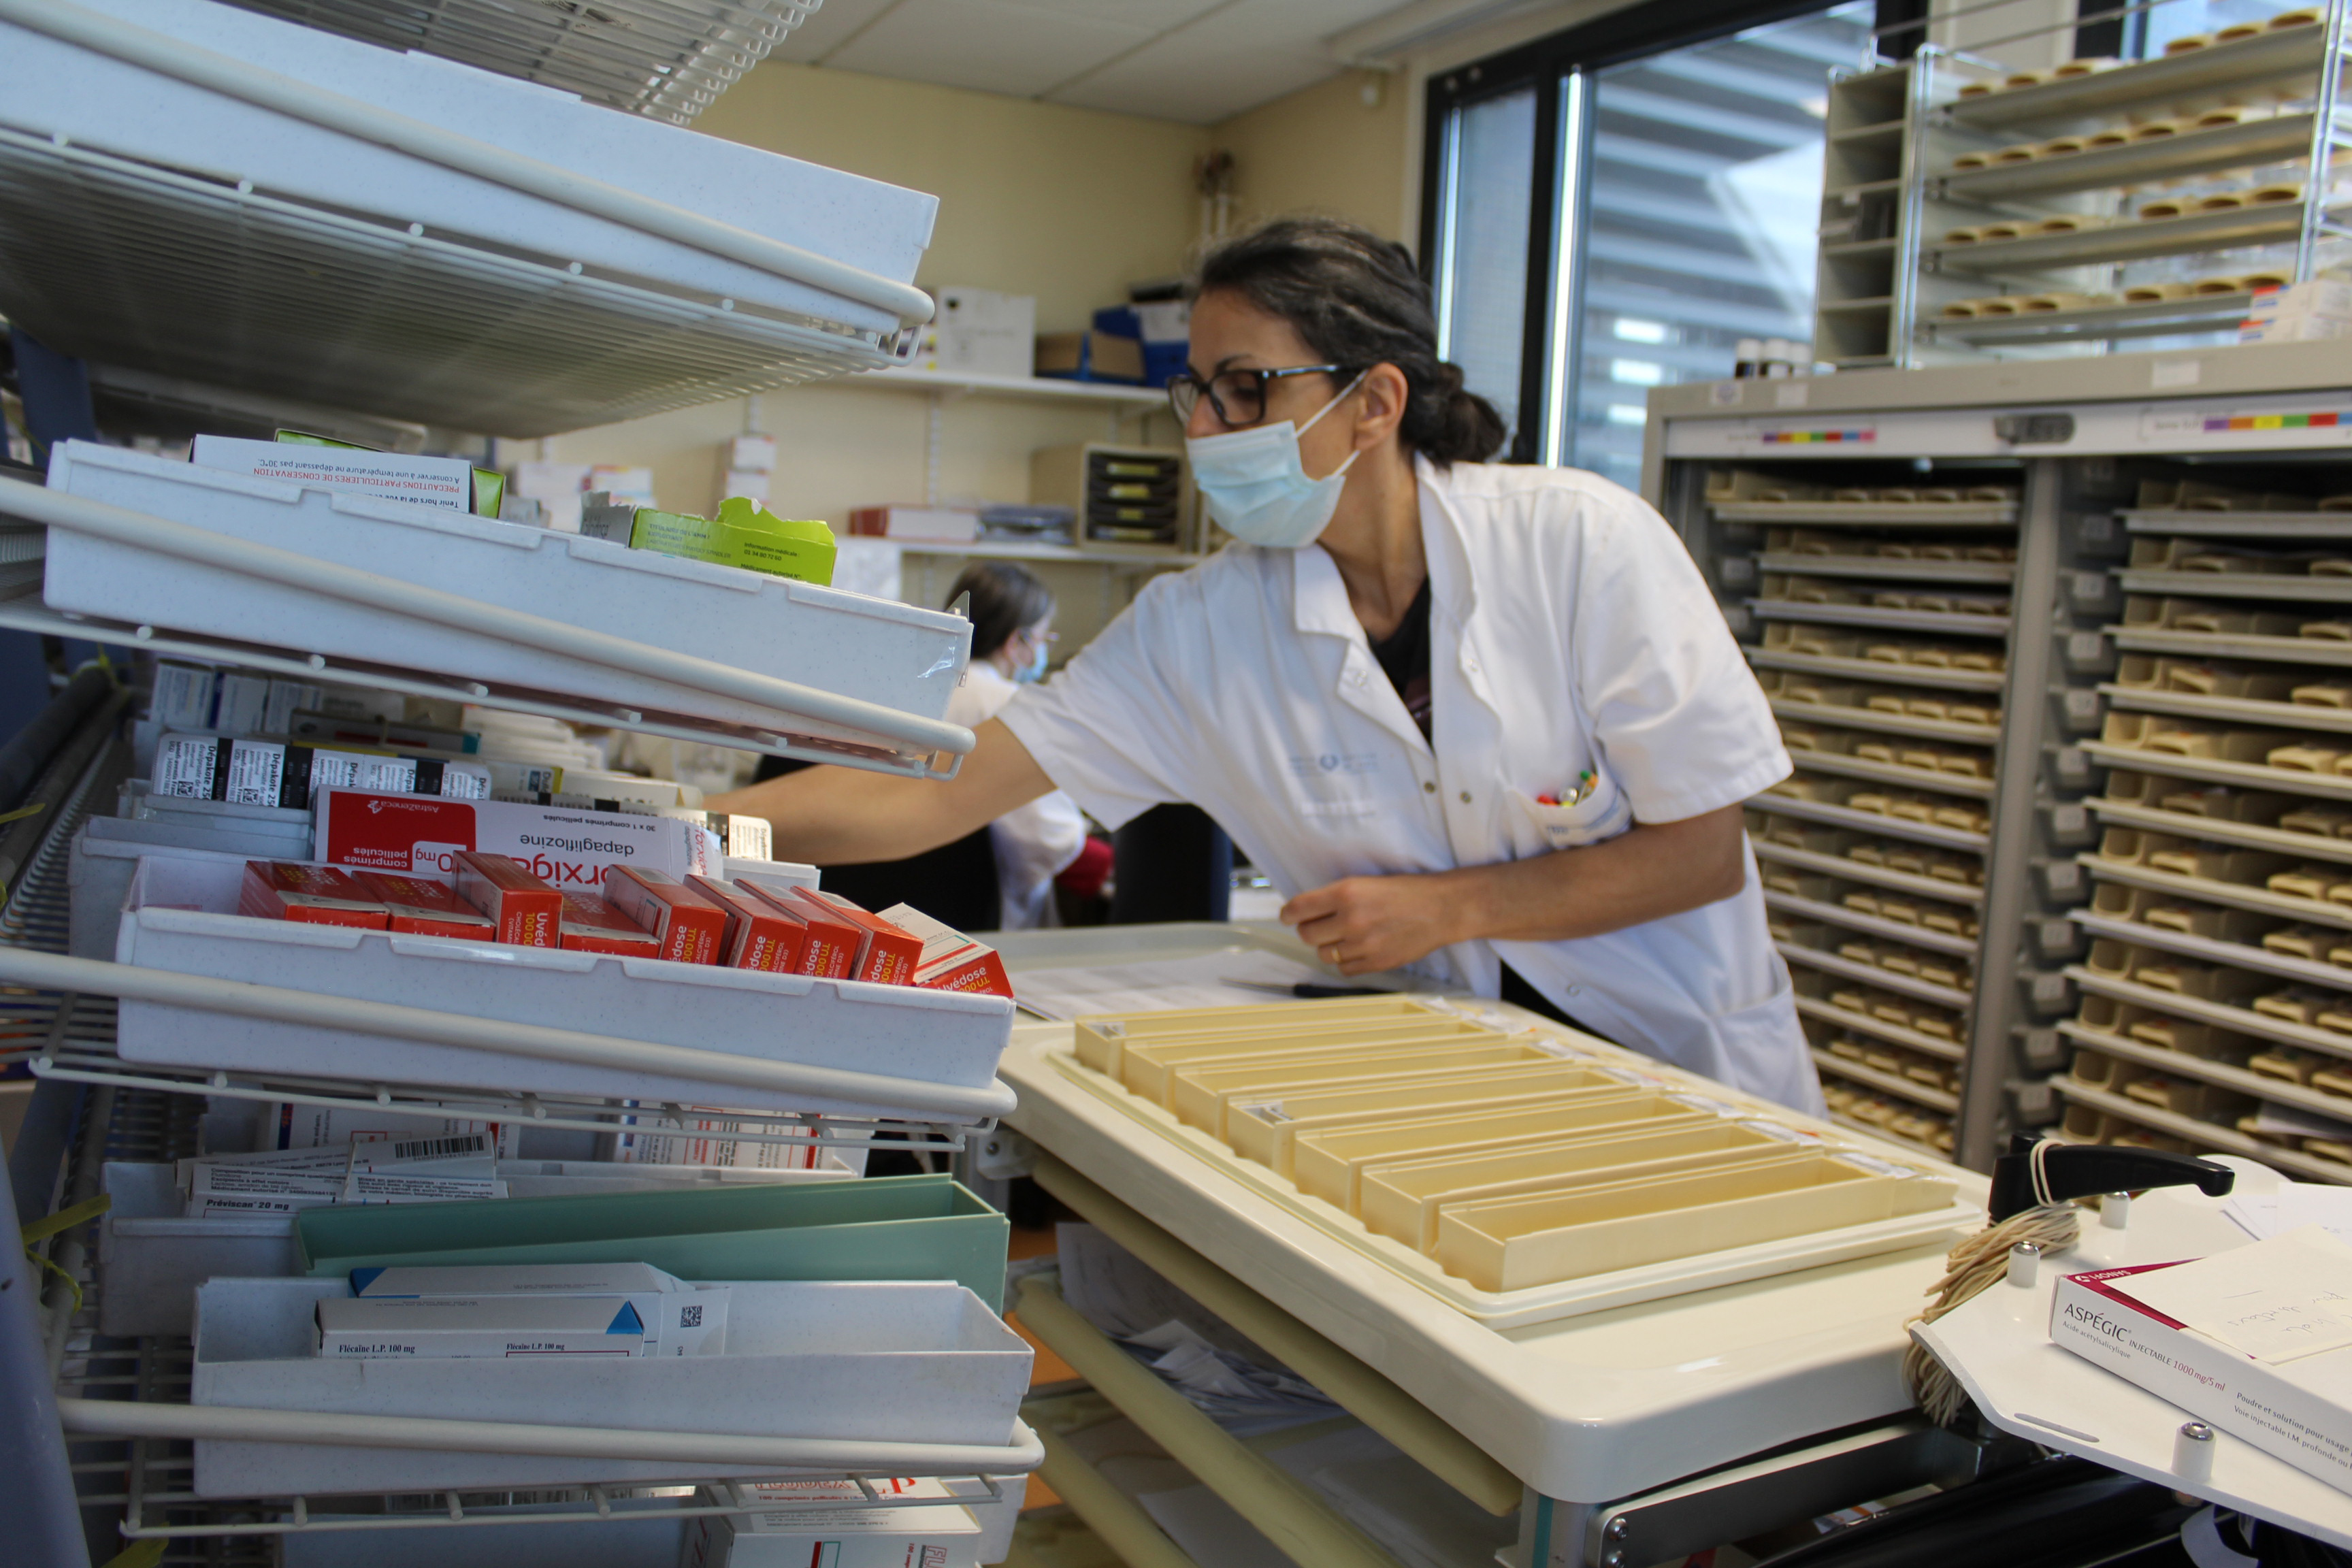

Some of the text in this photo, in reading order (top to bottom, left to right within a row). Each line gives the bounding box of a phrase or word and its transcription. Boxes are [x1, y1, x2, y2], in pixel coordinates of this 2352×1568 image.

[295, 462, 333, 472] dépassant
[346, 466, 393, 478] température
[254, 468, 459, 493] PRECAUTIONS PARTICULIERES DE CONSERVATION
[410, 472, 415, 480] à
[416, 473, 453, 482] conserver
[409, 497, 418, 505] de
[421, 497, 437, 506] hors
[440, 500, 459, 508] Tenir
[744, 542, 774, 552] Information
[775, 548, 797, 557] médicale
[740, 564, 772, 574] Médicament
[204, 745, 217, 785] Dépakote
[269, 753, 281, 792] Dépakote
[348, 762, 358, 787] Dépak
[406, 769, 415, 792] Dépak
[478, 777, 486, 800] Dépa
[381, 800, 439, 813] AstraZeneca
[543, 815, 583, 824] pelliculés
[585, 818, 630, 830] comprimés
[353, 847, 408, 860] pelliculés
[520, 835, 634, 858] dapagliflozine
[416, 848, 436, 862] mg
[344, 856, 407, 870] comprimés
[534, 913, 548, 947] Uvéd
[669, 926, 687, 962] édose
[746, 936, 766, 970] édose
[803, 940, 821, 976] édose
[2089, 1270, 2132, 1280] SANOFI
[2063, 1320, 2131, 1360] Acide acétylsalicylique
[339, 1344, 415, 1354] Flécaïne L.P. 100 mg
[2129, 1339, 2172, 1366] INJECTABLE
[2173, 1360, 2193, 1376] 1000
[2194, 1371, 2214, 1386] mg/5
[2215, 1383, 2225, 1392] ml
[2236, 1392, 2350, 1453] Poudre et solution pour usage
[2234, 1405, 2348, 1468] Voie injectable I.M. profonde ou
